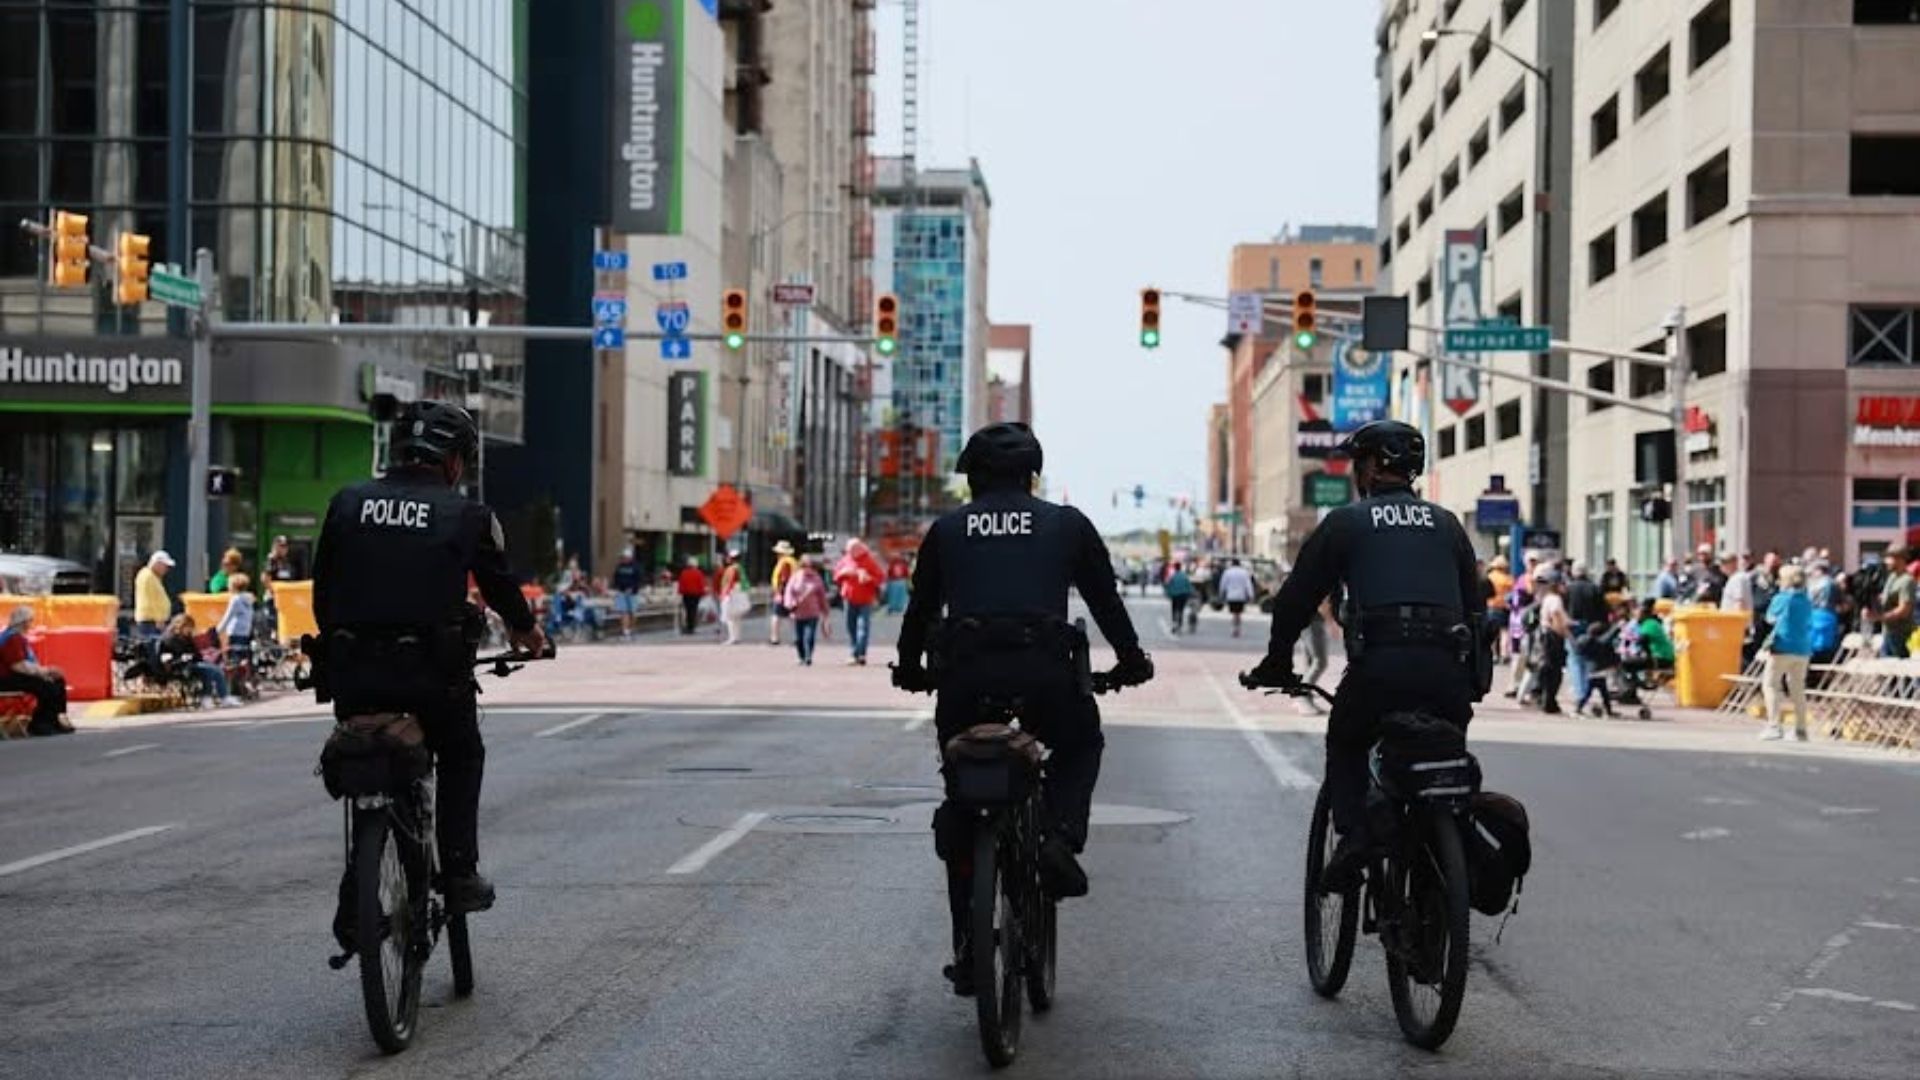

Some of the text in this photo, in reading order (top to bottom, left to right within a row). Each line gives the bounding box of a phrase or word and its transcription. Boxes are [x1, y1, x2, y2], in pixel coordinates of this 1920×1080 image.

[620, 43, 664, 210] Huntington
[661, 310, 686, 330] 70
[1452, 332, 1542, 348] Market St
[0, 347, 182, 393] Huntington
[681, 377, 696, 469] PARK
[360, 499, 430, 528] POLICE
[967, 511, 1032, 536] POLICE
[1371, 504, 1434, 527] POLICE
